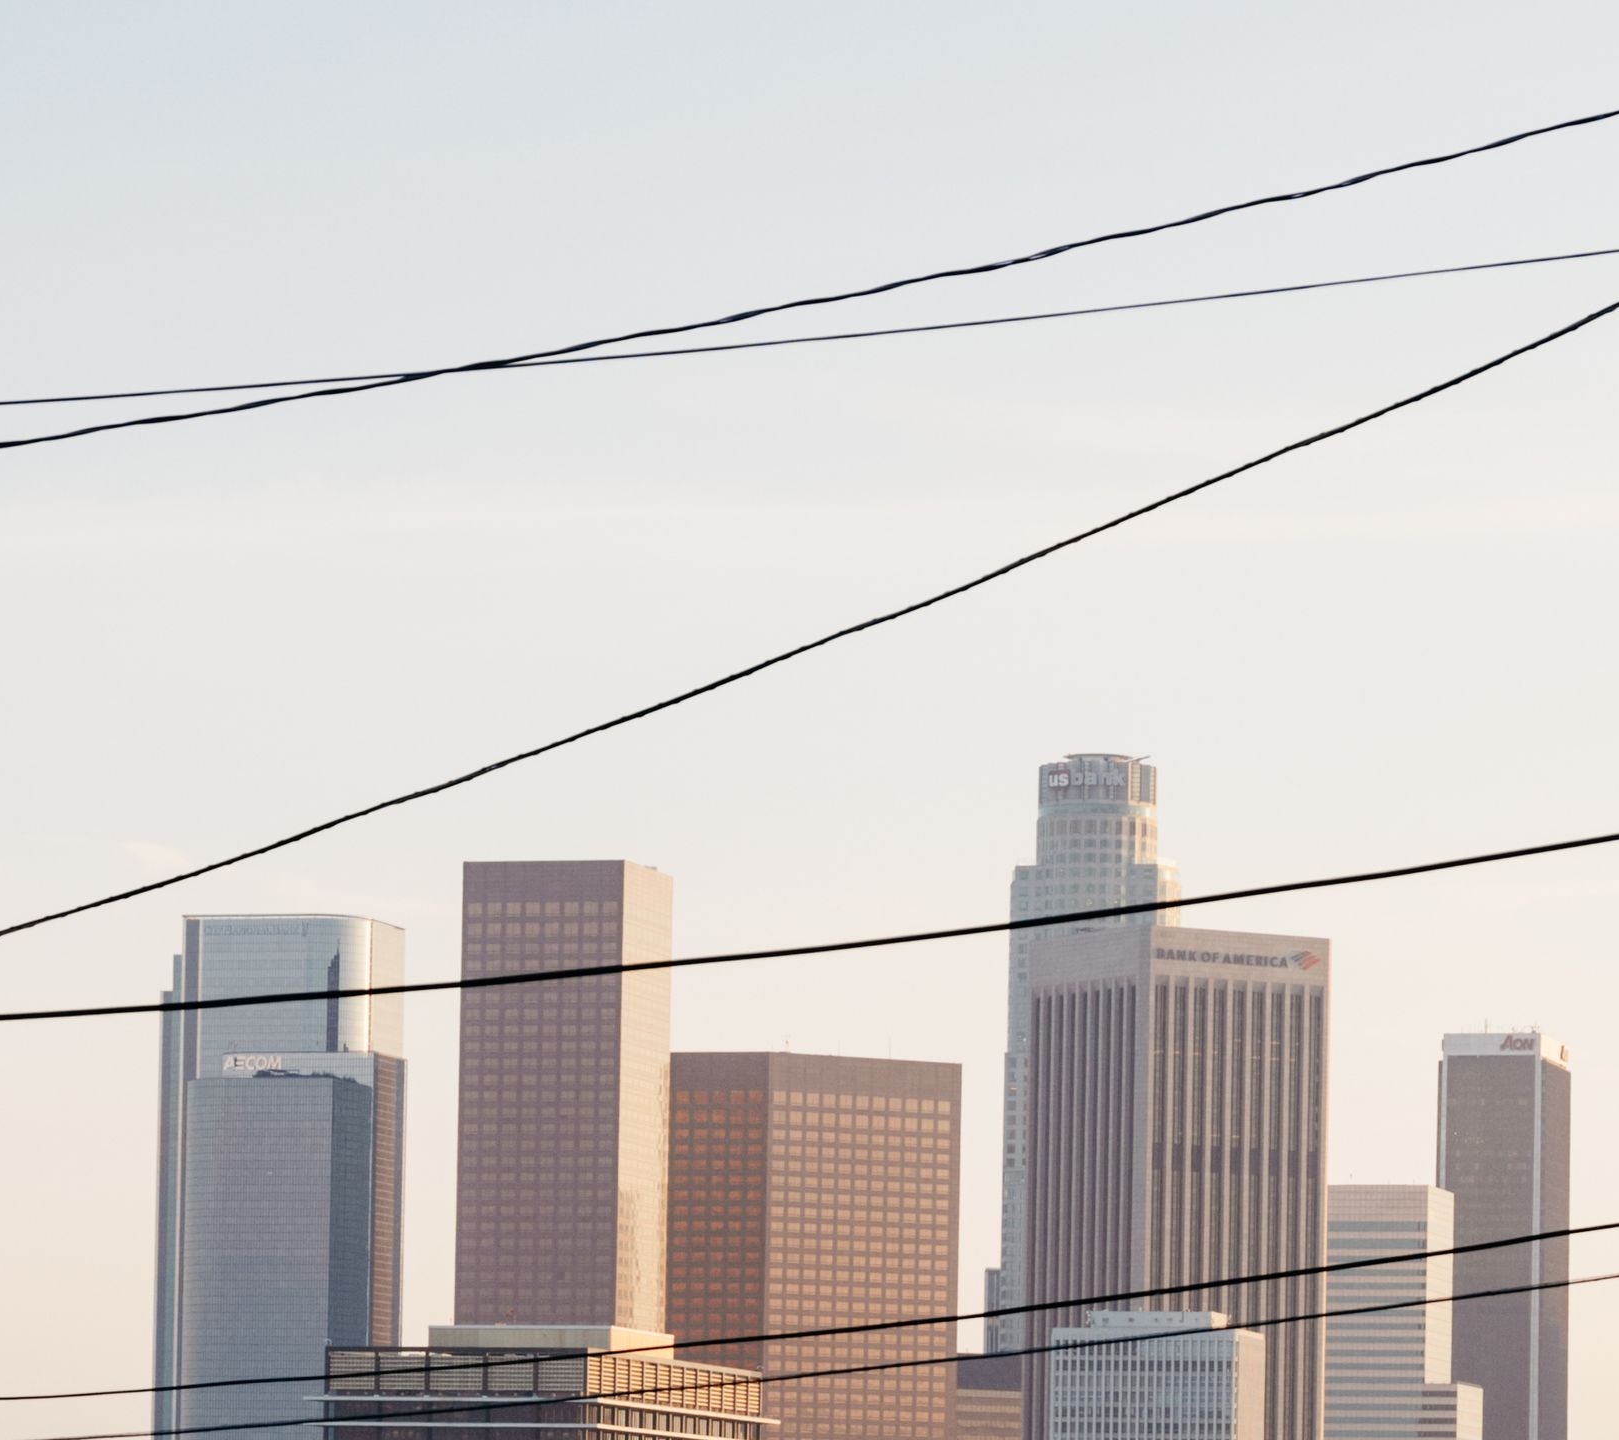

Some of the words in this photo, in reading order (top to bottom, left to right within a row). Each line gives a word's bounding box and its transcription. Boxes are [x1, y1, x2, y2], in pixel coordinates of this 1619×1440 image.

[1155, 948, 1197, 962] BANK
[1200, 952, 1219, 963] OF
[1222, 953, 1288, 968] AMERICA
[222, 1055, 282, 1070] AECOM
